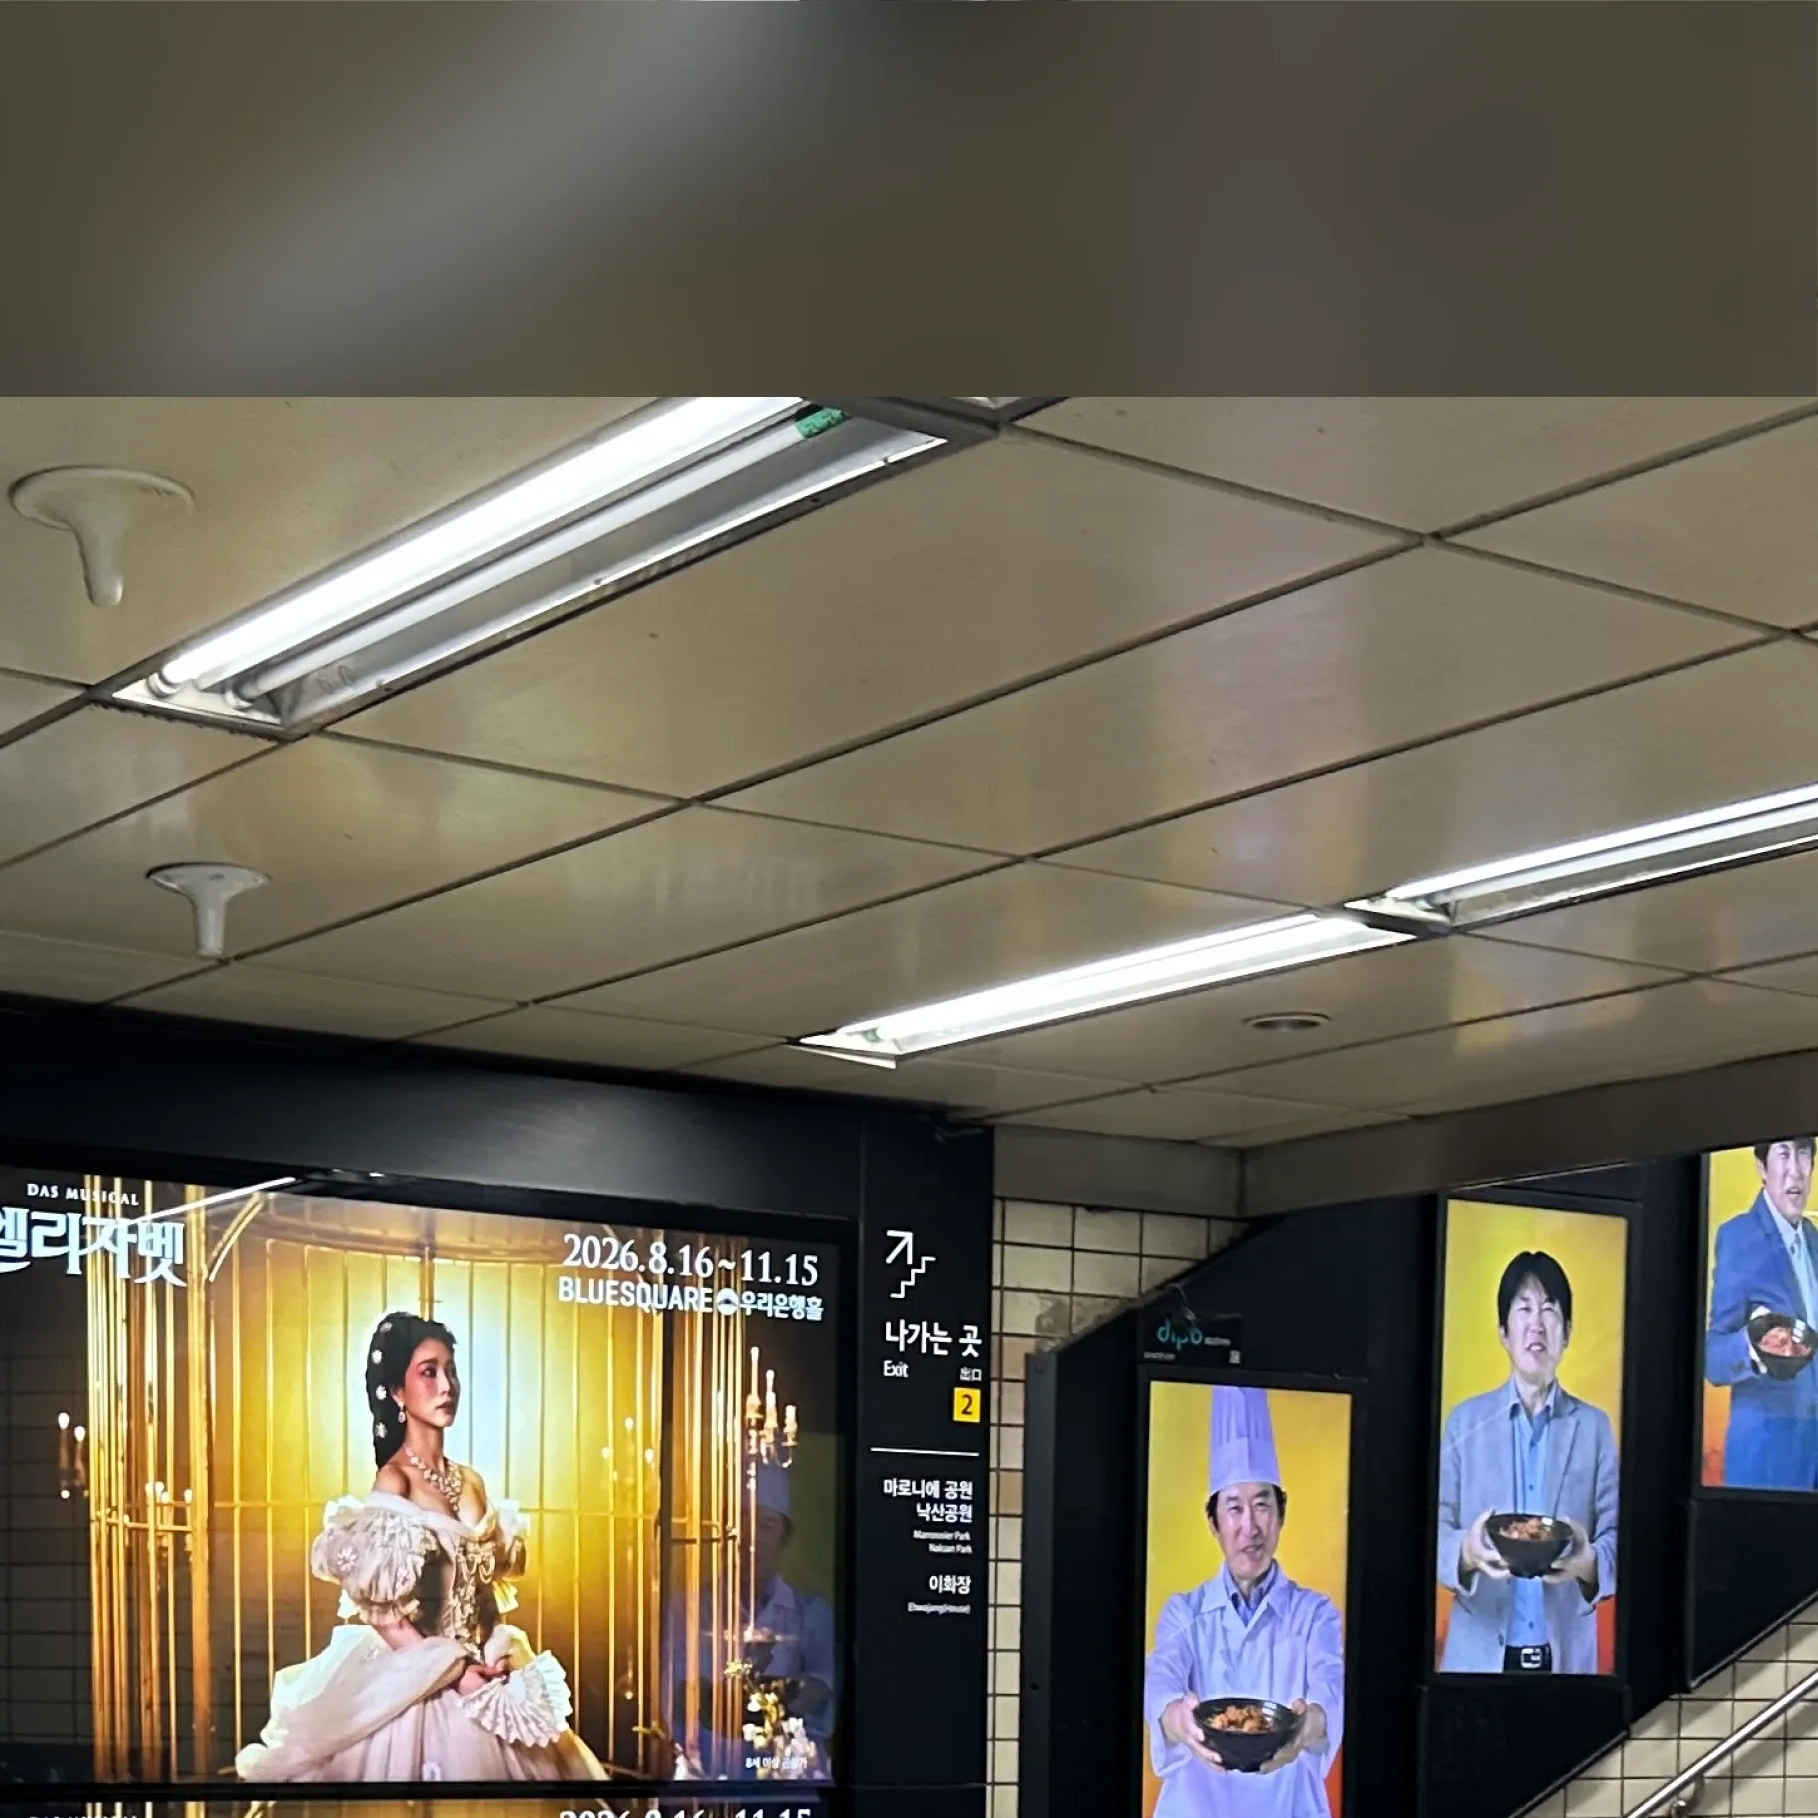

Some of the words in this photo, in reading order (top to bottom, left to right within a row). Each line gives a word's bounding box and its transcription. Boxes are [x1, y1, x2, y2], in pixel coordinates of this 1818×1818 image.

[27, 1184, 59, 1199] DAS
[66, 1188, 139, 1206] MUSICAL
[563, 1233, 819, 1287] 2026.8.16~11.15
[558, 1276, 714, 1314] BLUESQUARE
[740, 1290, 824, 1321] 우리은행홀
[885, 1319, 952, 1355] 나가는
[958, 1325, 982, 1357] 곳
[883, 1360, 909, 1377] Exit
[961, 1394, 973, 1415] 2
[883, 1478, 940, 1499] 마로니에
[944, 1480, 973, 1500] 공원
[916, 1502, 973, 1523] 낙산공원
[929, 1574, 972, 1595] 이화장
